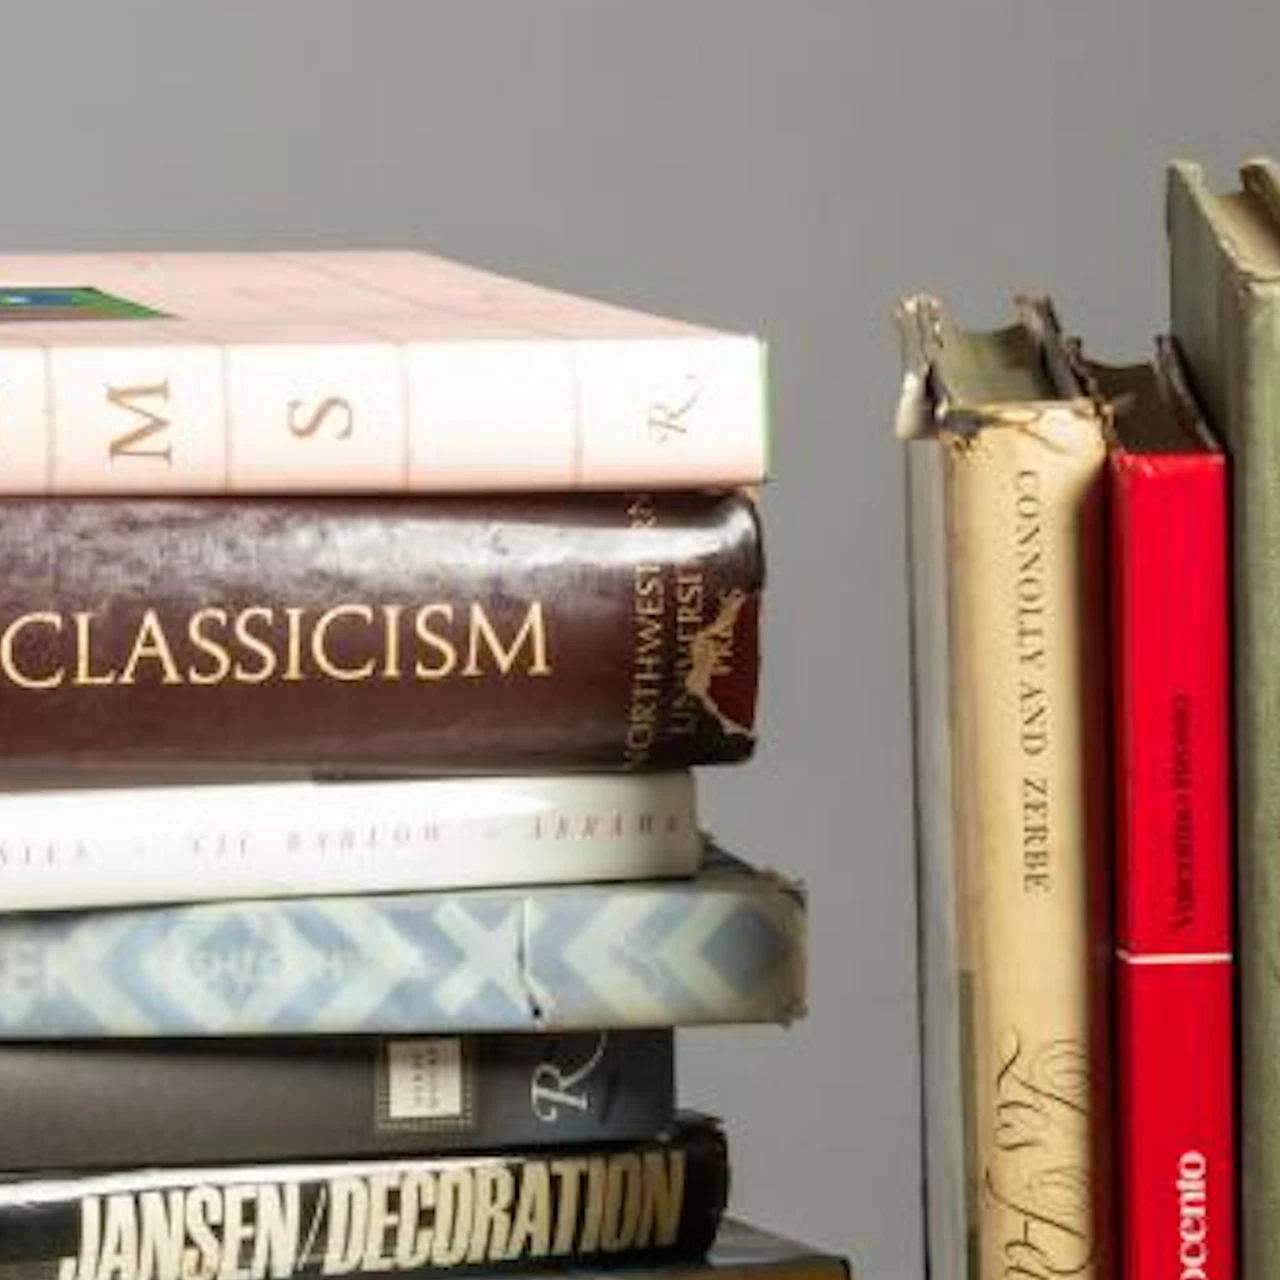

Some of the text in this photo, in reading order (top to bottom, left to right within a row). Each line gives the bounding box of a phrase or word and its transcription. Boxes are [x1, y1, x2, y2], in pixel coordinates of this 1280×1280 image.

[1013, 469, 1052, 895] CONNOLLY AND ZERBE
